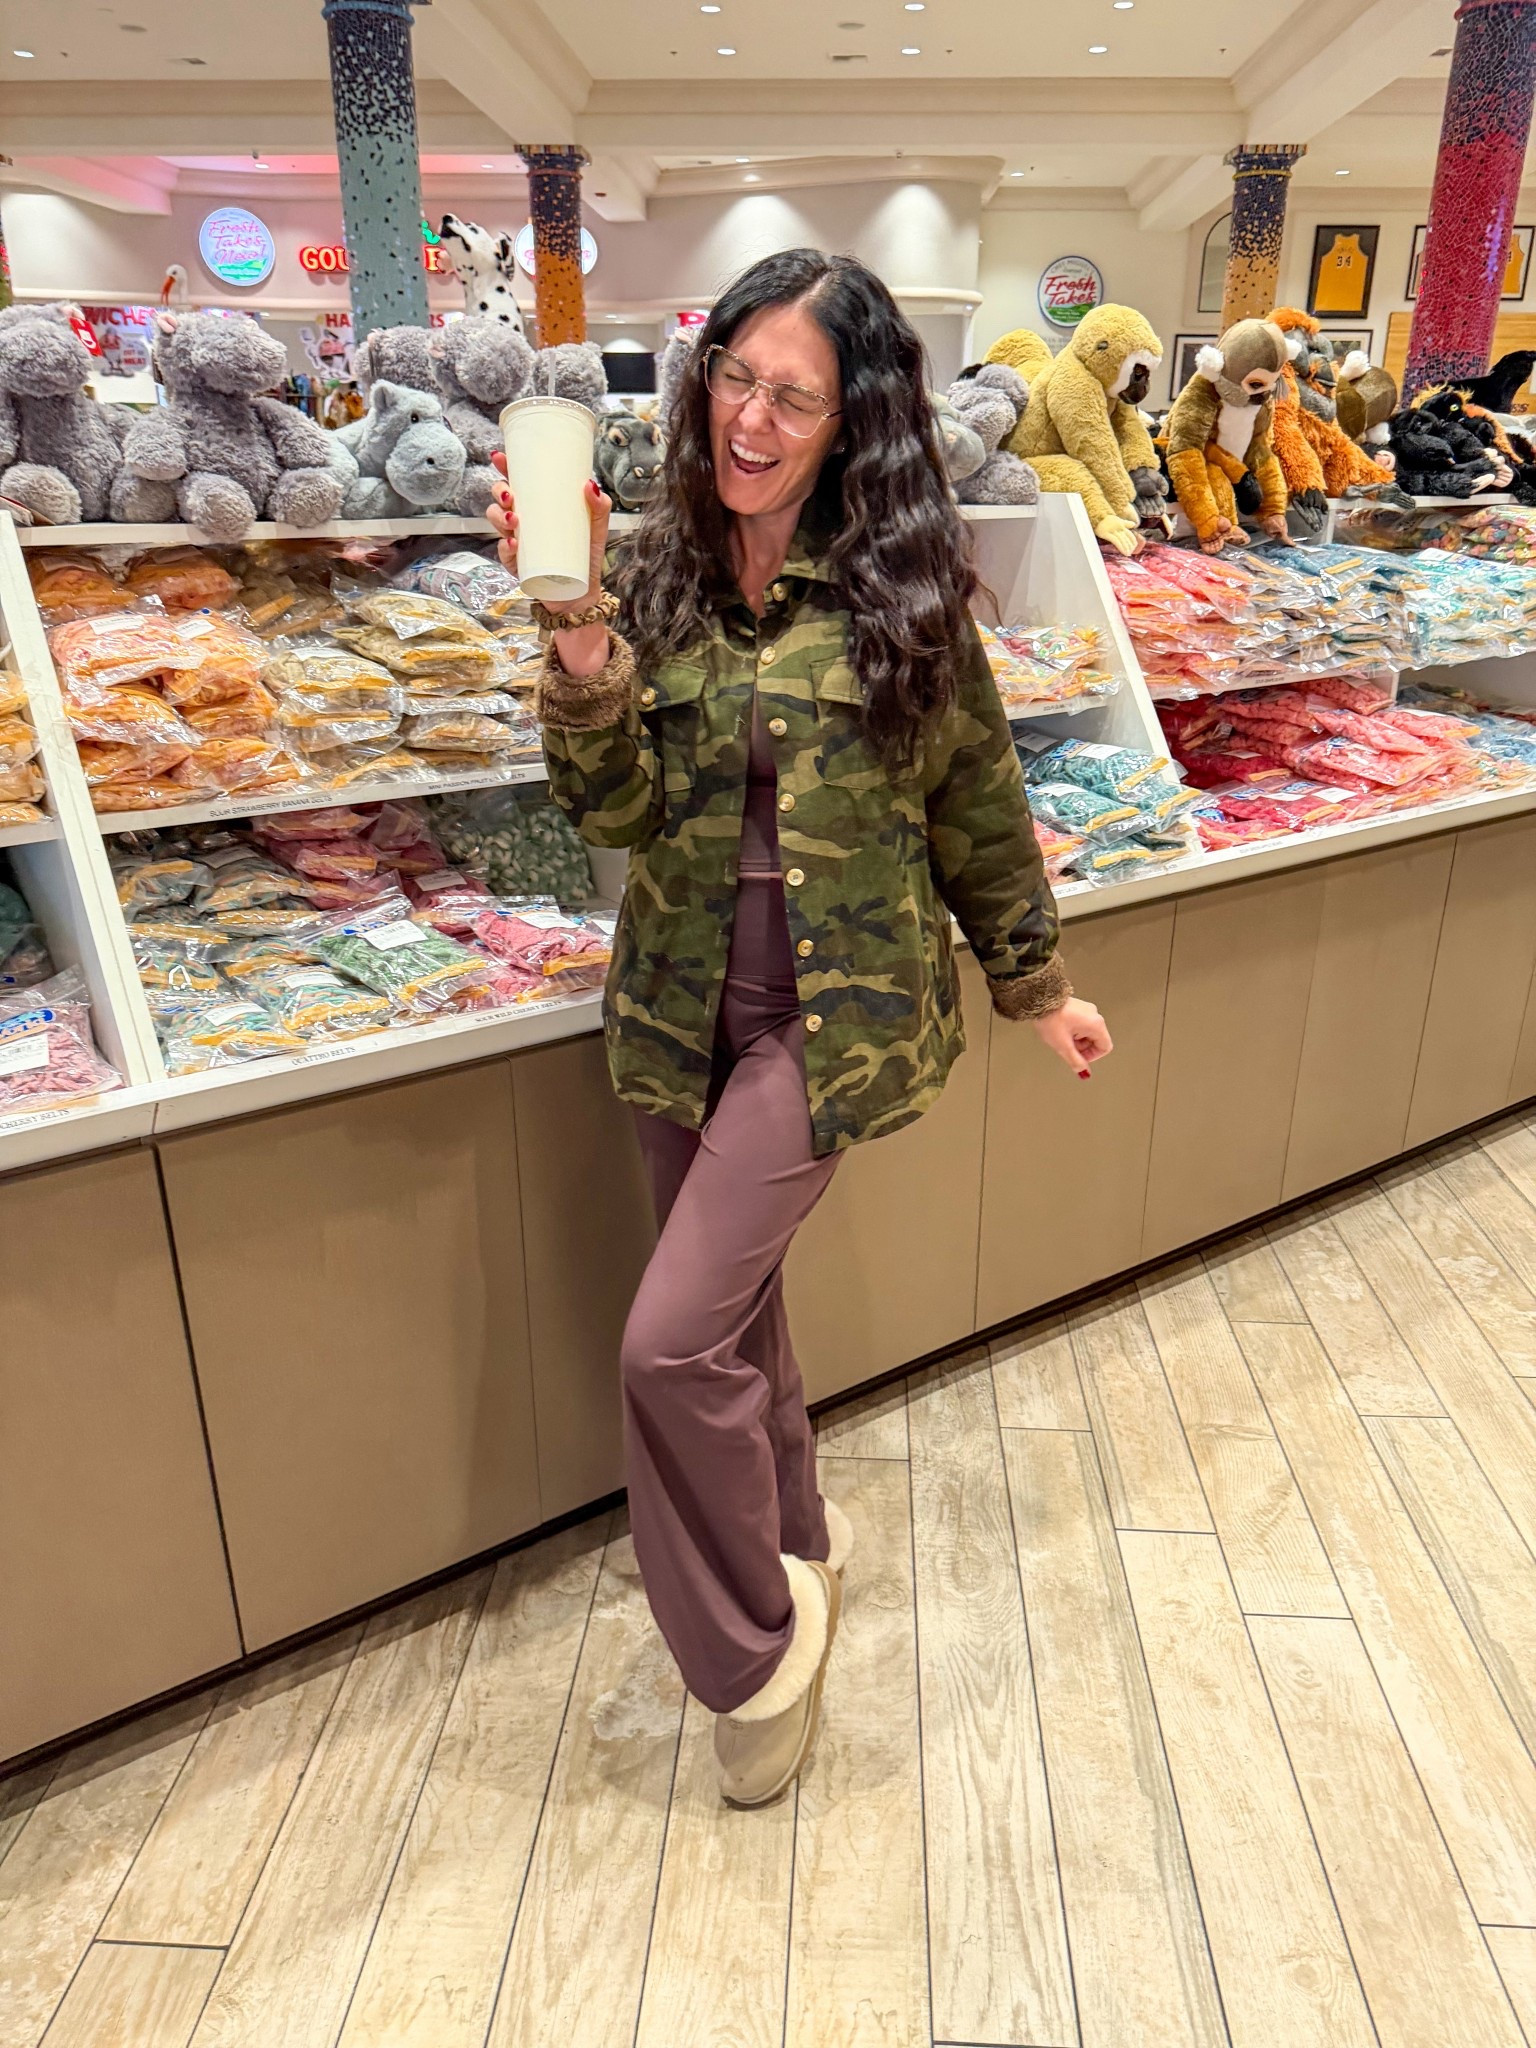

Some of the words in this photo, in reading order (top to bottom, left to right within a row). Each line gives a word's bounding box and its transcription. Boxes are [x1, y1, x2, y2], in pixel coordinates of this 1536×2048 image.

[208, 219, 260, 237] Fresh
[212, 233, 266, 249] Takes
[1336, 255, 1352, 267] 34
[1044, 272, 1097, 294] Fresh
[1048, 290, 1098, 310] Takes
[231, 802, 281, 815] STRAWBERRY
[281, 797, 310, 808] BANANA
